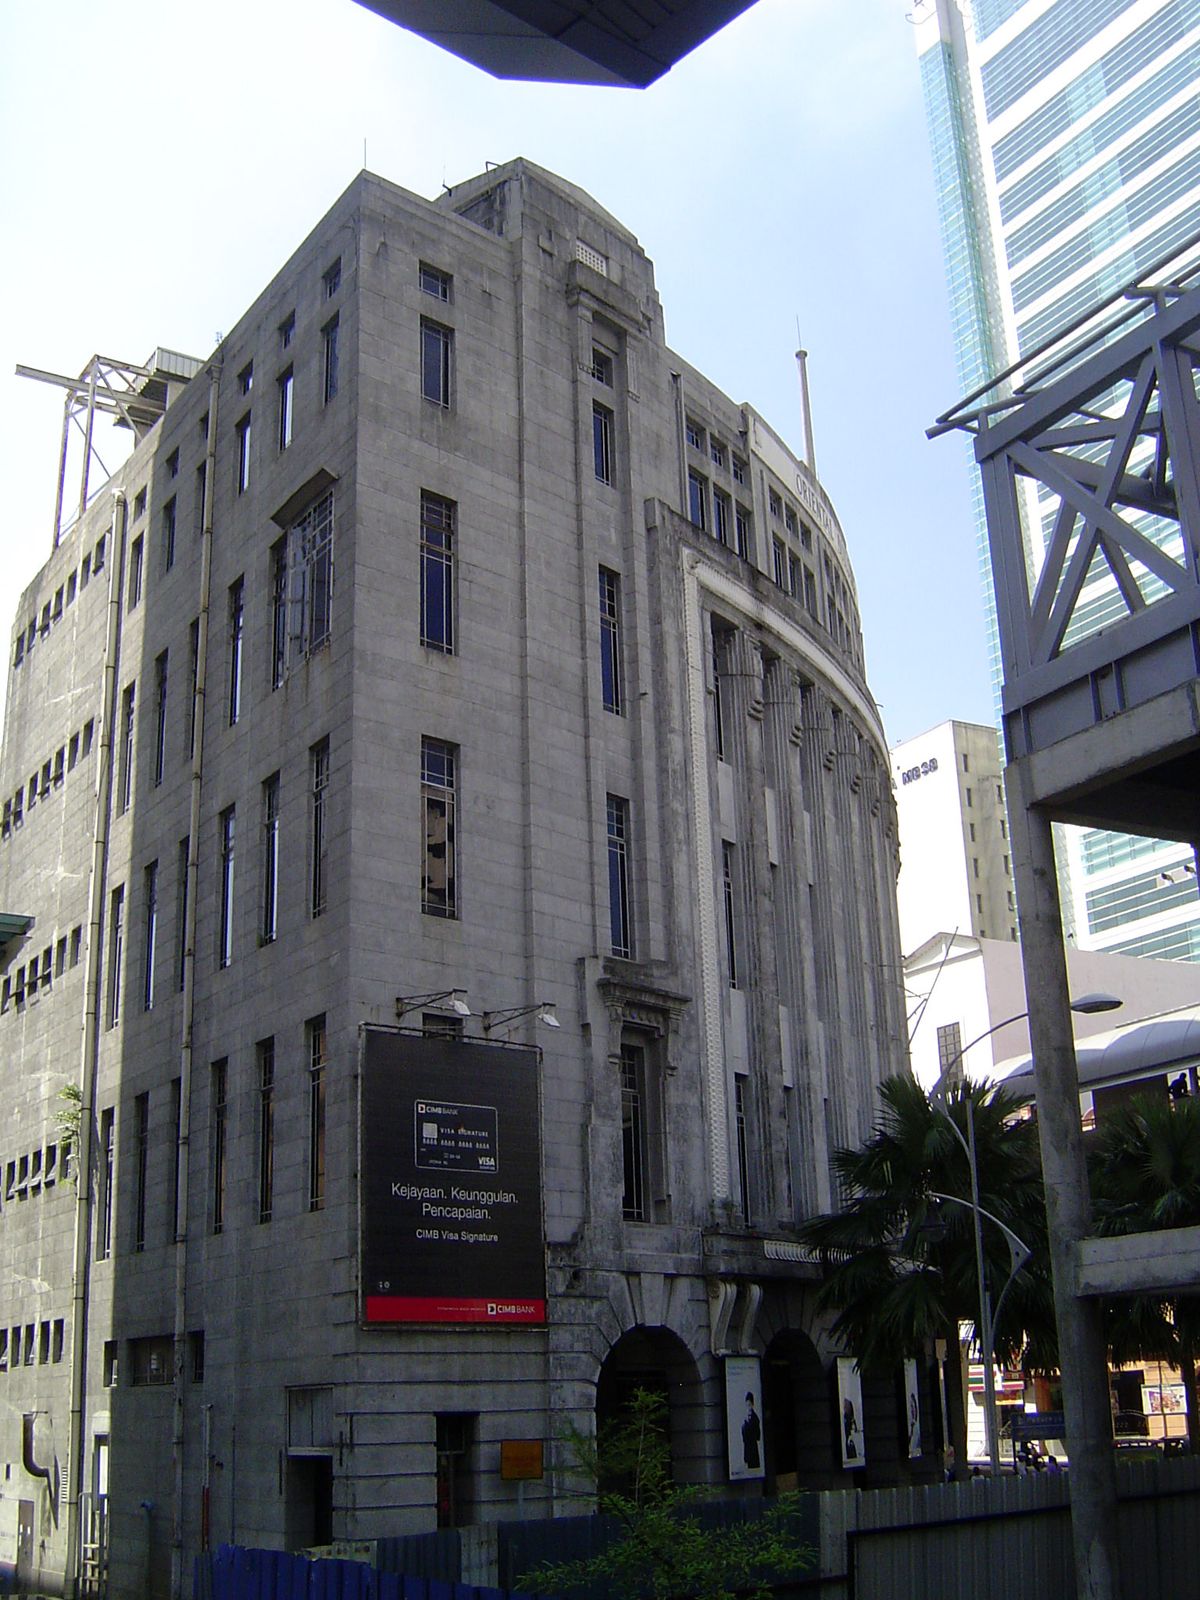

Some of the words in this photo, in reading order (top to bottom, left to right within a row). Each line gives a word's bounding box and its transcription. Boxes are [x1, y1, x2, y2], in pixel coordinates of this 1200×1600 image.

[478, 1156, 495, 1166] VISA
[391, 1182, 447, 1201] Kejayaan.
[451, 1186, 519, 1205] Keunggulan.
[422, 1202, 492, 1220] Pencapaian.
[416, 1229, 439, 1240] CIMB
[441, 1230, 459, 1240] Visa
[461, 1231, 499, 1243] Signature
[497, 1305, 516, 1314] CIMB
